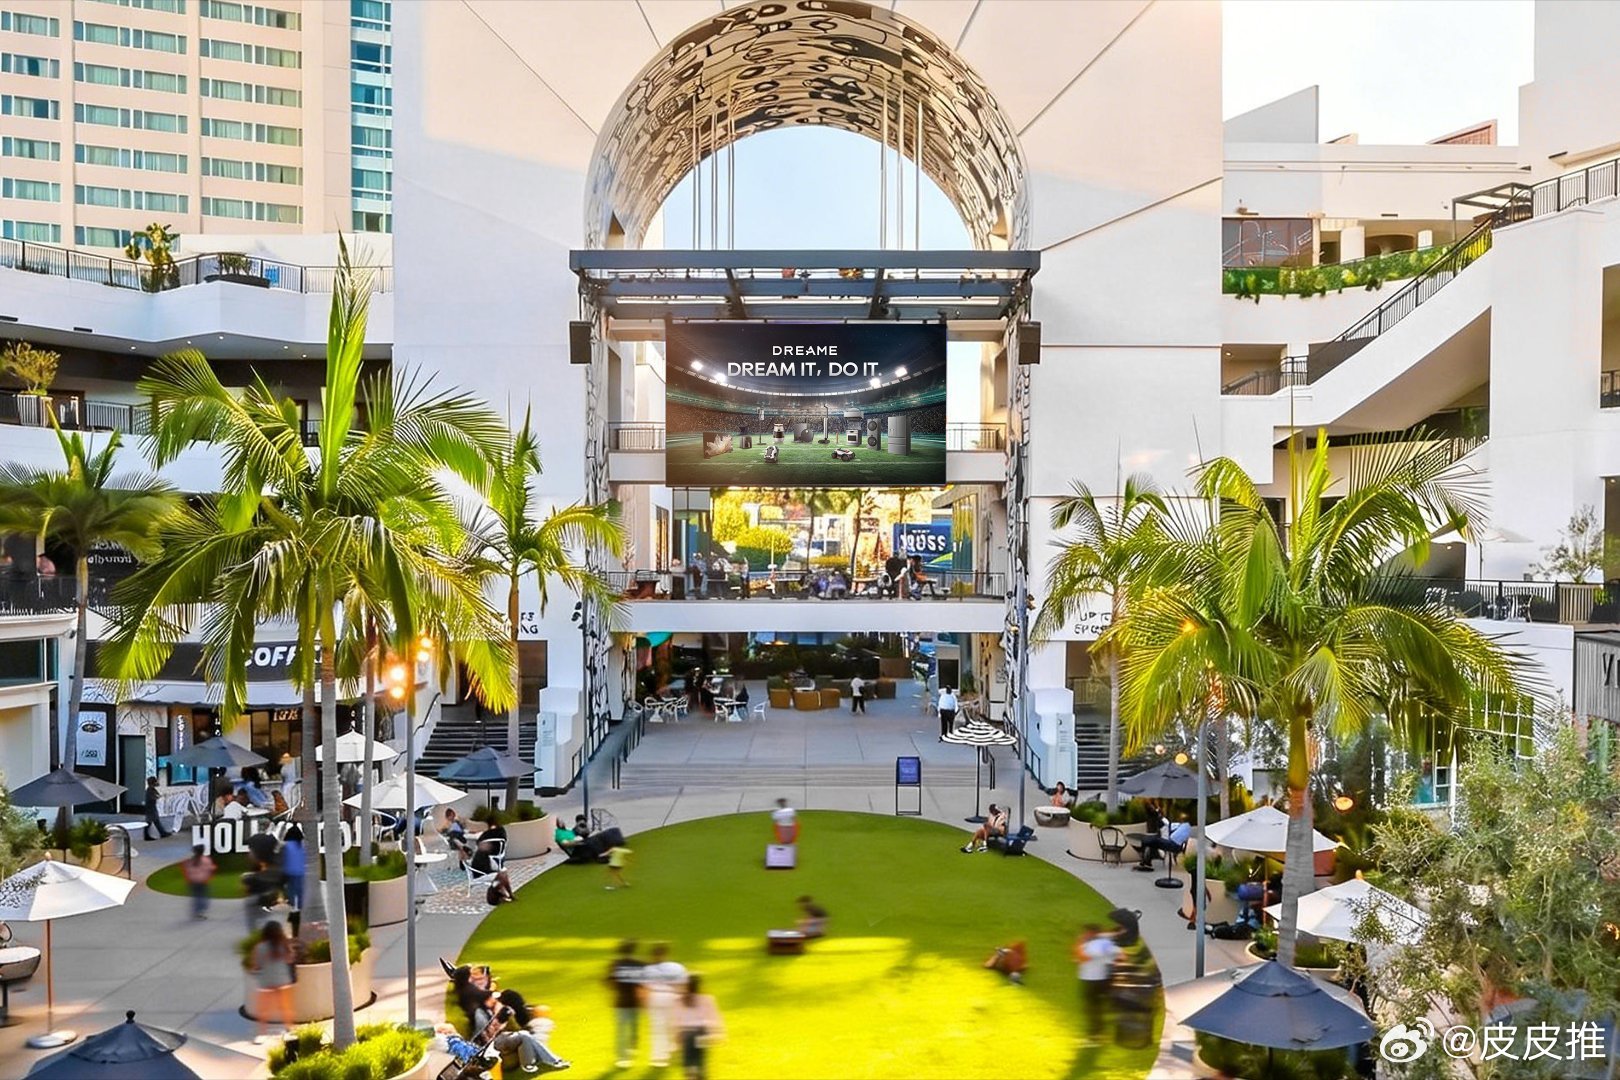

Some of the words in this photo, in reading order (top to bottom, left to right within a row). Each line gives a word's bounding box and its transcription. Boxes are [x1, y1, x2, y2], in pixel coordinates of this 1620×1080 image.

[772, 345, 838, 356] DREAME
[727, 362, 796, 377] DREAM
[801, 362, 822, 377] IT,
[828, 362, 858, 377] DO
[863, 362, 882, 377] IT.
